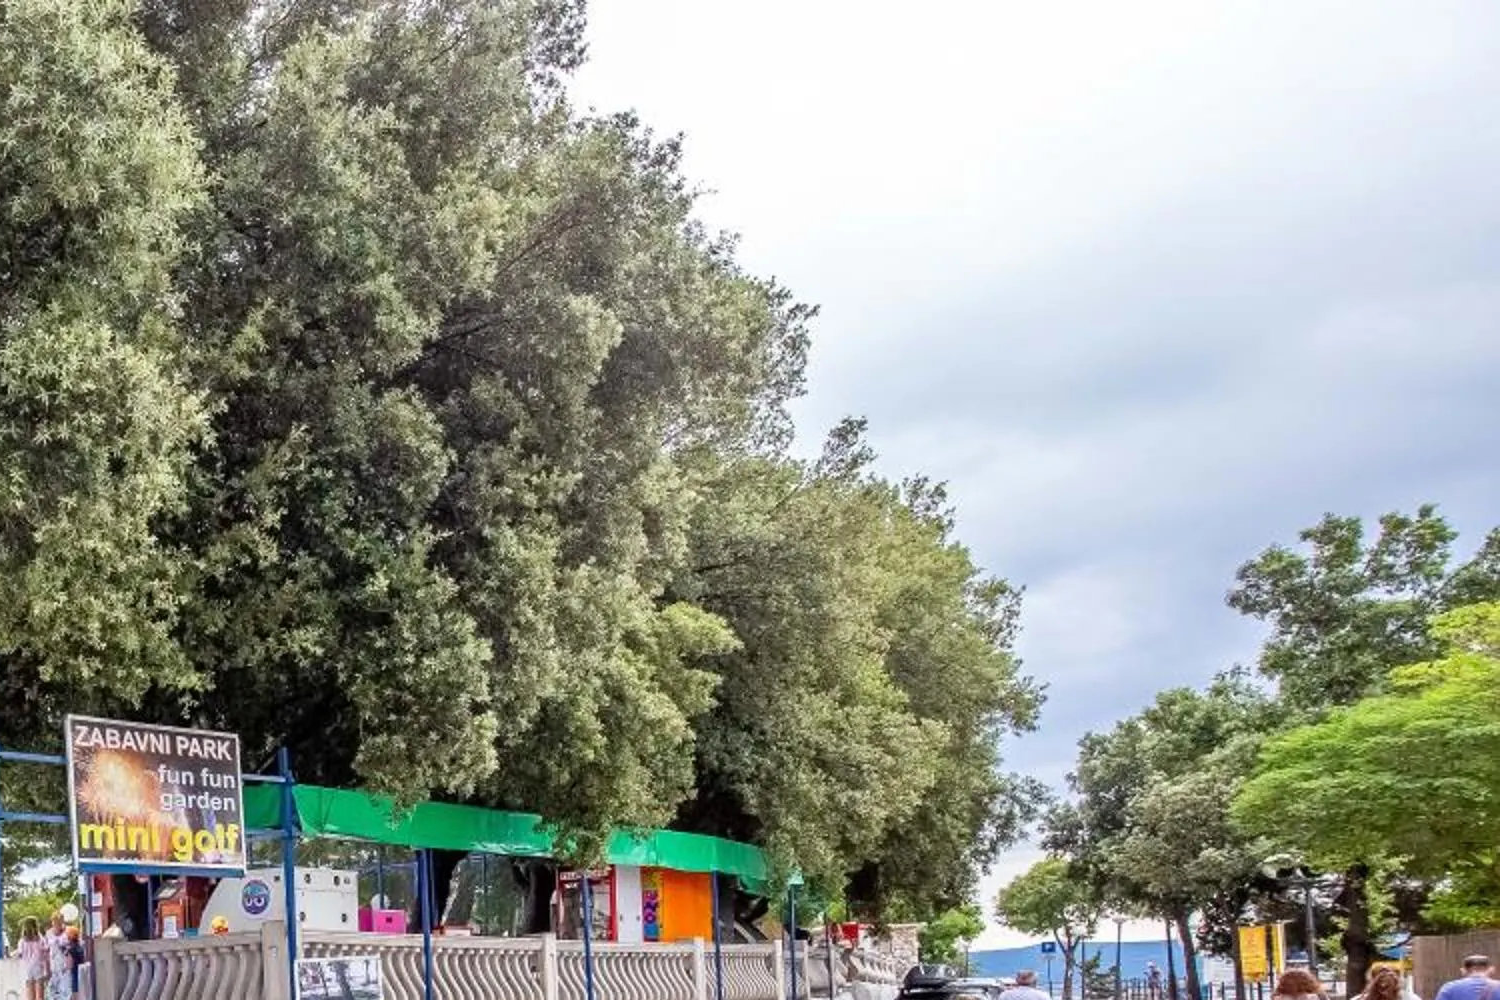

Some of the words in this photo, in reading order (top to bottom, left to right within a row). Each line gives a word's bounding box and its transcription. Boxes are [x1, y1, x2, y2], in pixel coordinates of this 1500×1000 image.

[74, 725, 171, 755] ZABAVNI
[175, 736, 232, 761] PARK
[157, 763, 194, 787] fun
[200, 767, 236, 790] fun
[159, 792, 236, 811] garden
[79, 818, 161, 852] mini
[170, 822, 240, 861] golf
